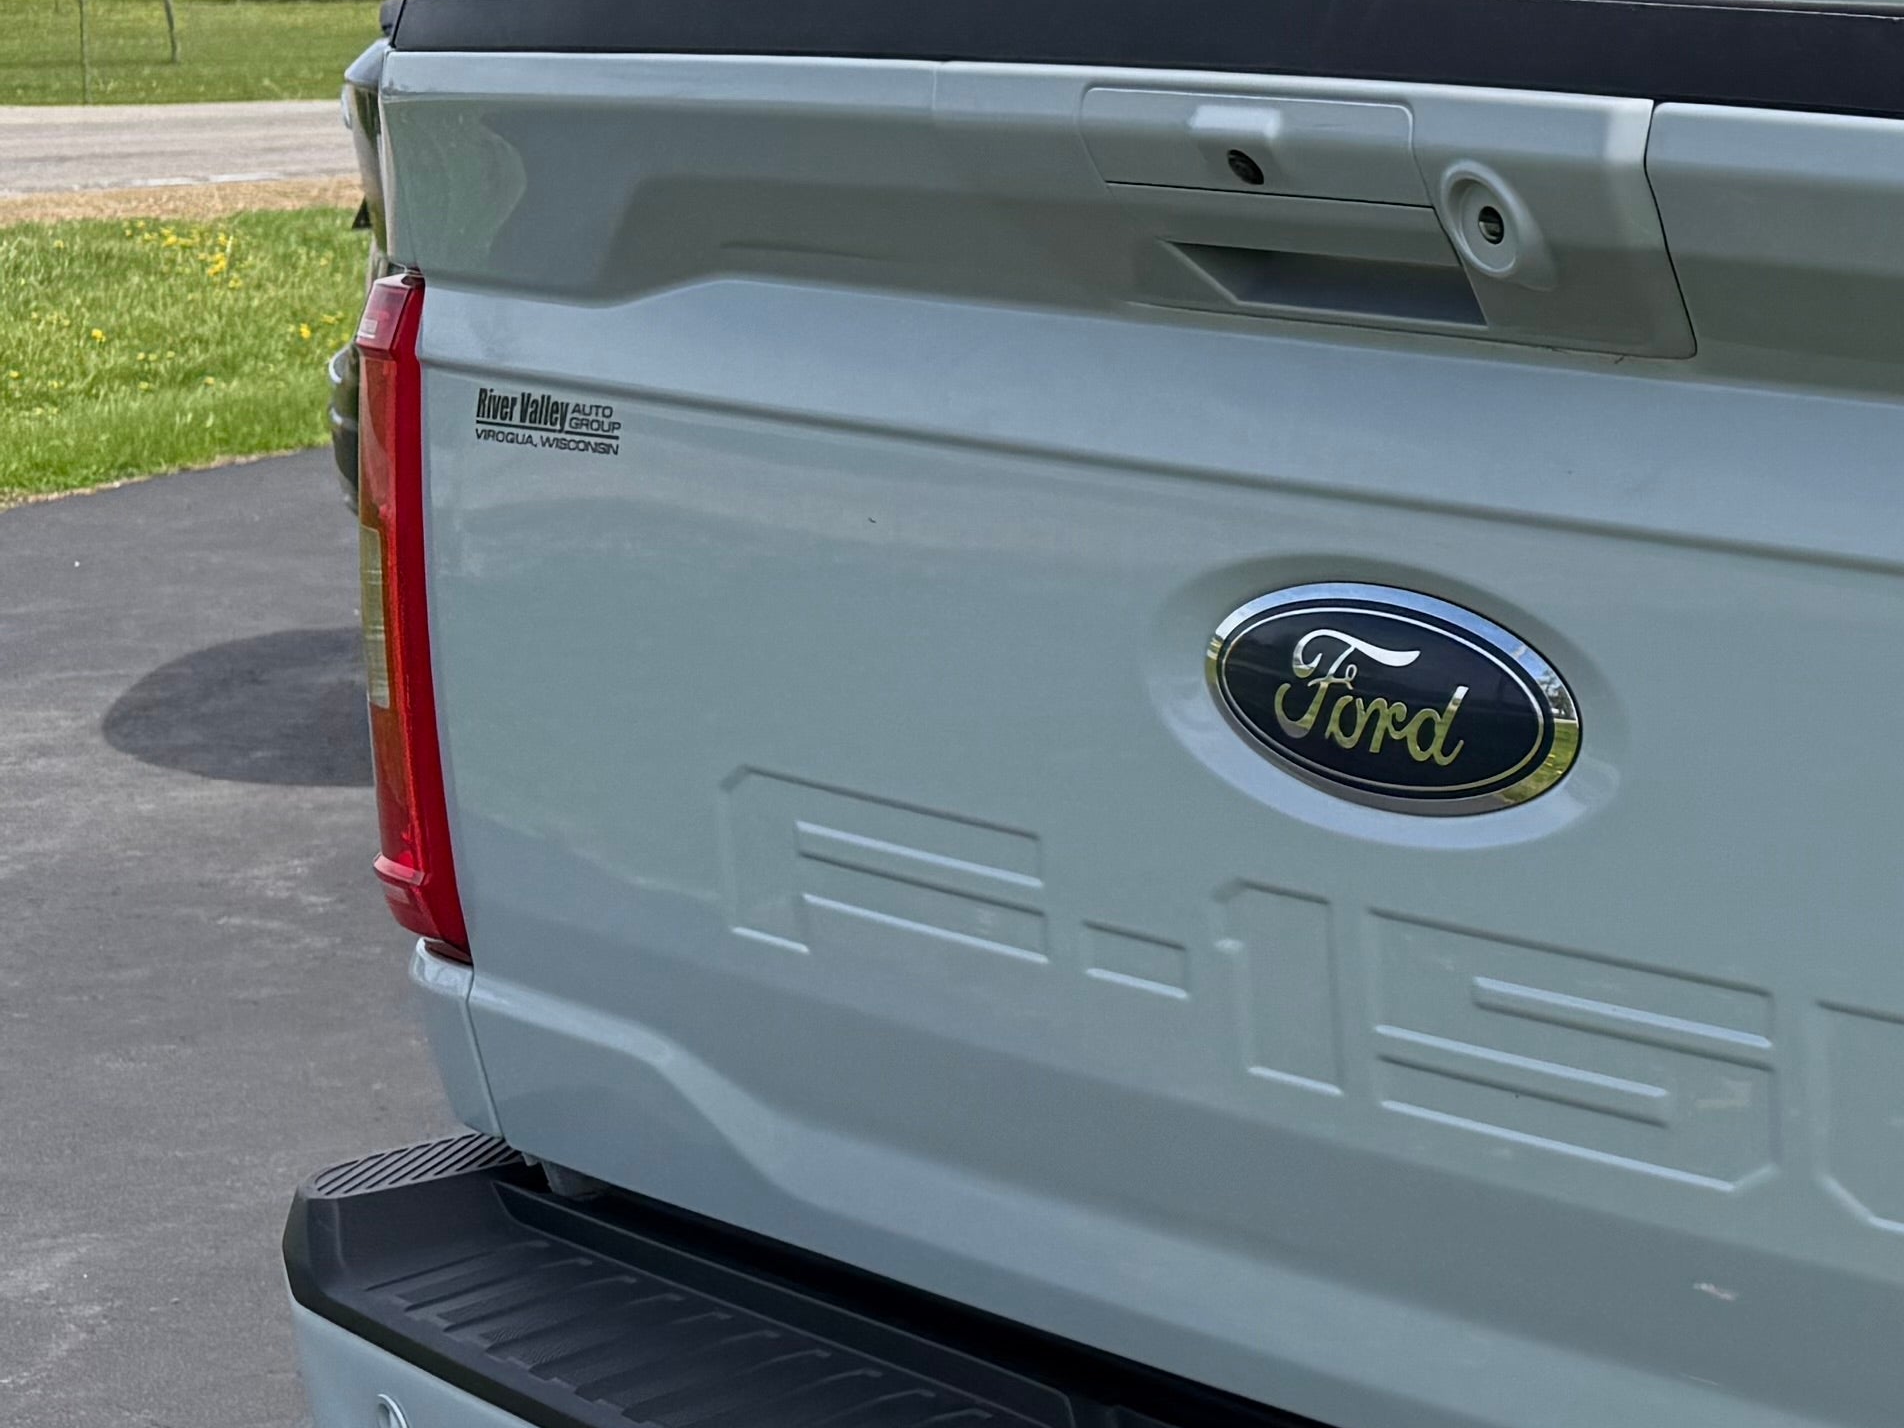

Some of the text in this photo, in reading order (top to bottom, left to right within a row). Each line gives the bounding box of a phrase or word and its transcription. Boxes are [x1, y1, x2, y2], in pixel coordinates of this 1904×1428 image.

[476, 388, 569, 433] River Valley
[571, 403, 613, 419] AUTO
[569, 417, 622, 434] GROUP
[540, 436, 620, 456] WISCONSIN
[1274, 629, 1469, 766] Ford
